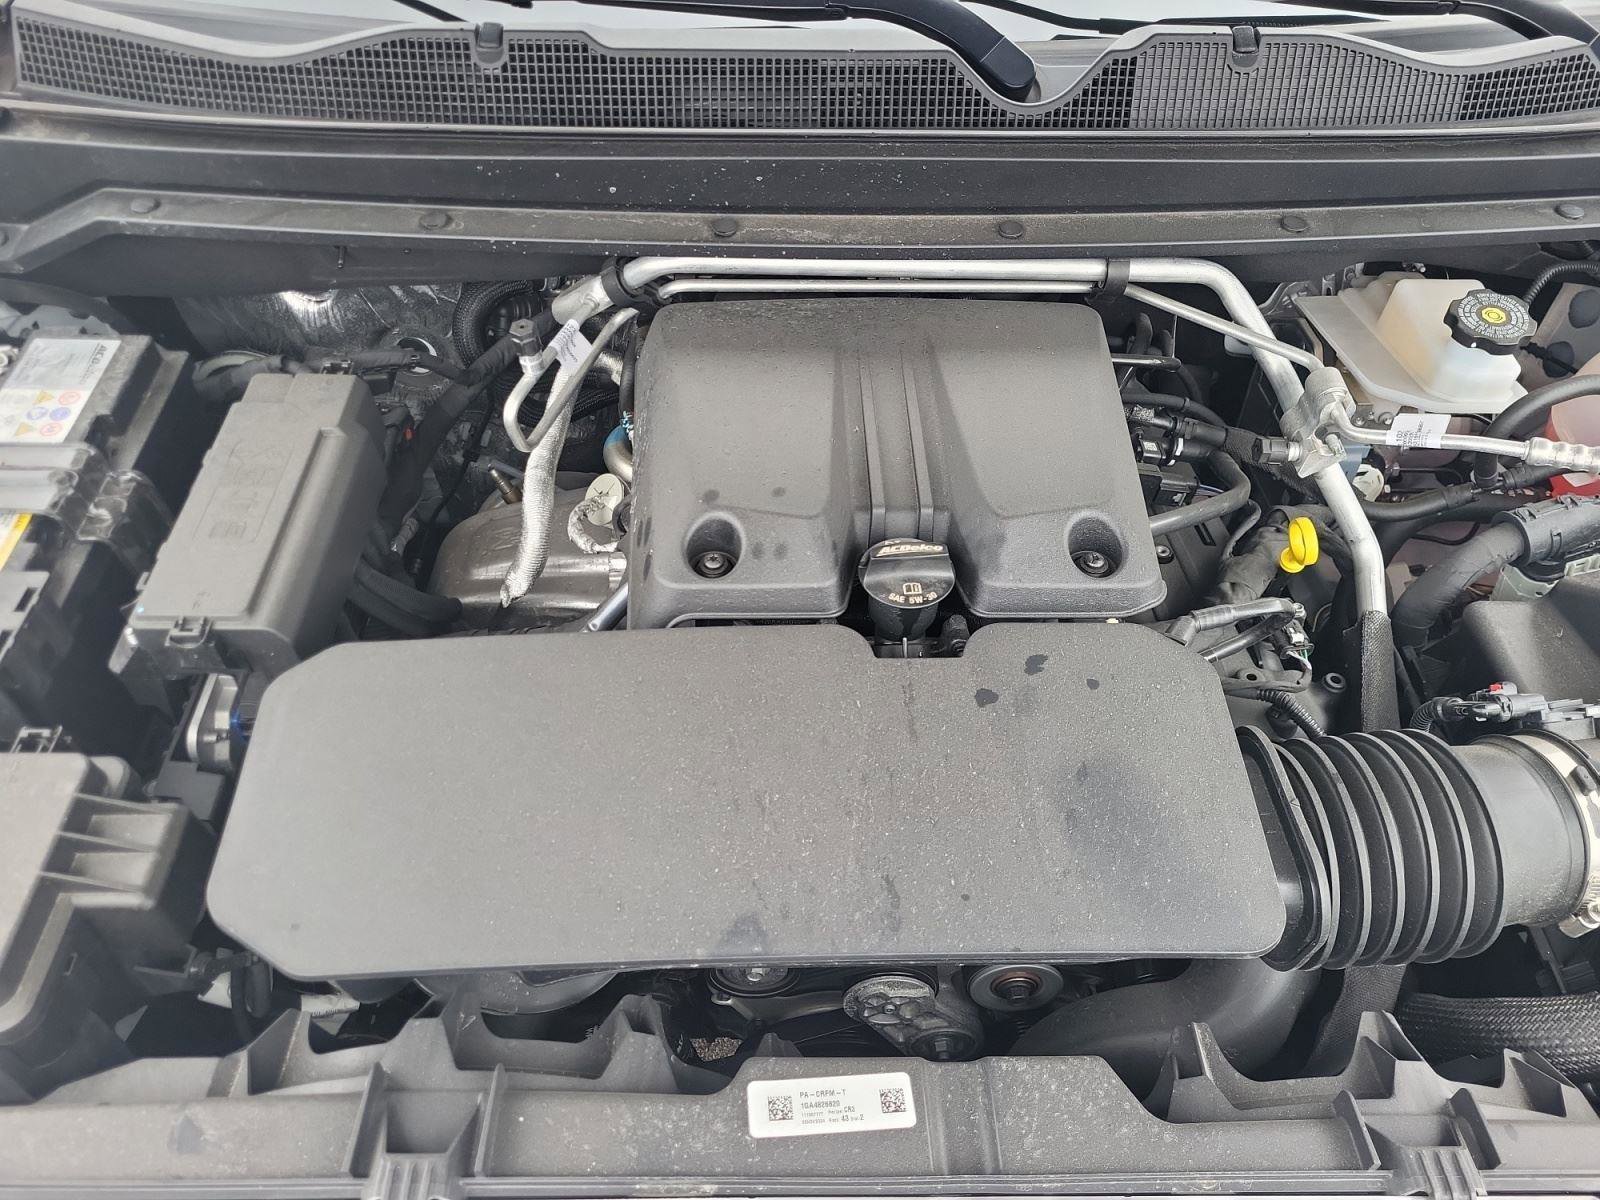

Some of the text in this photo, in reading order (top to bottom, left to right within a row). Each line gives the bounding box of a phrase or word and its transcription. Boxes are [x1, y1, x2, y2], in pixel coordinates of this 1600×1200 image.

[878, 544, 943, 555] ACDelco
[888, 591, 938, 604] SAE 5W-30
